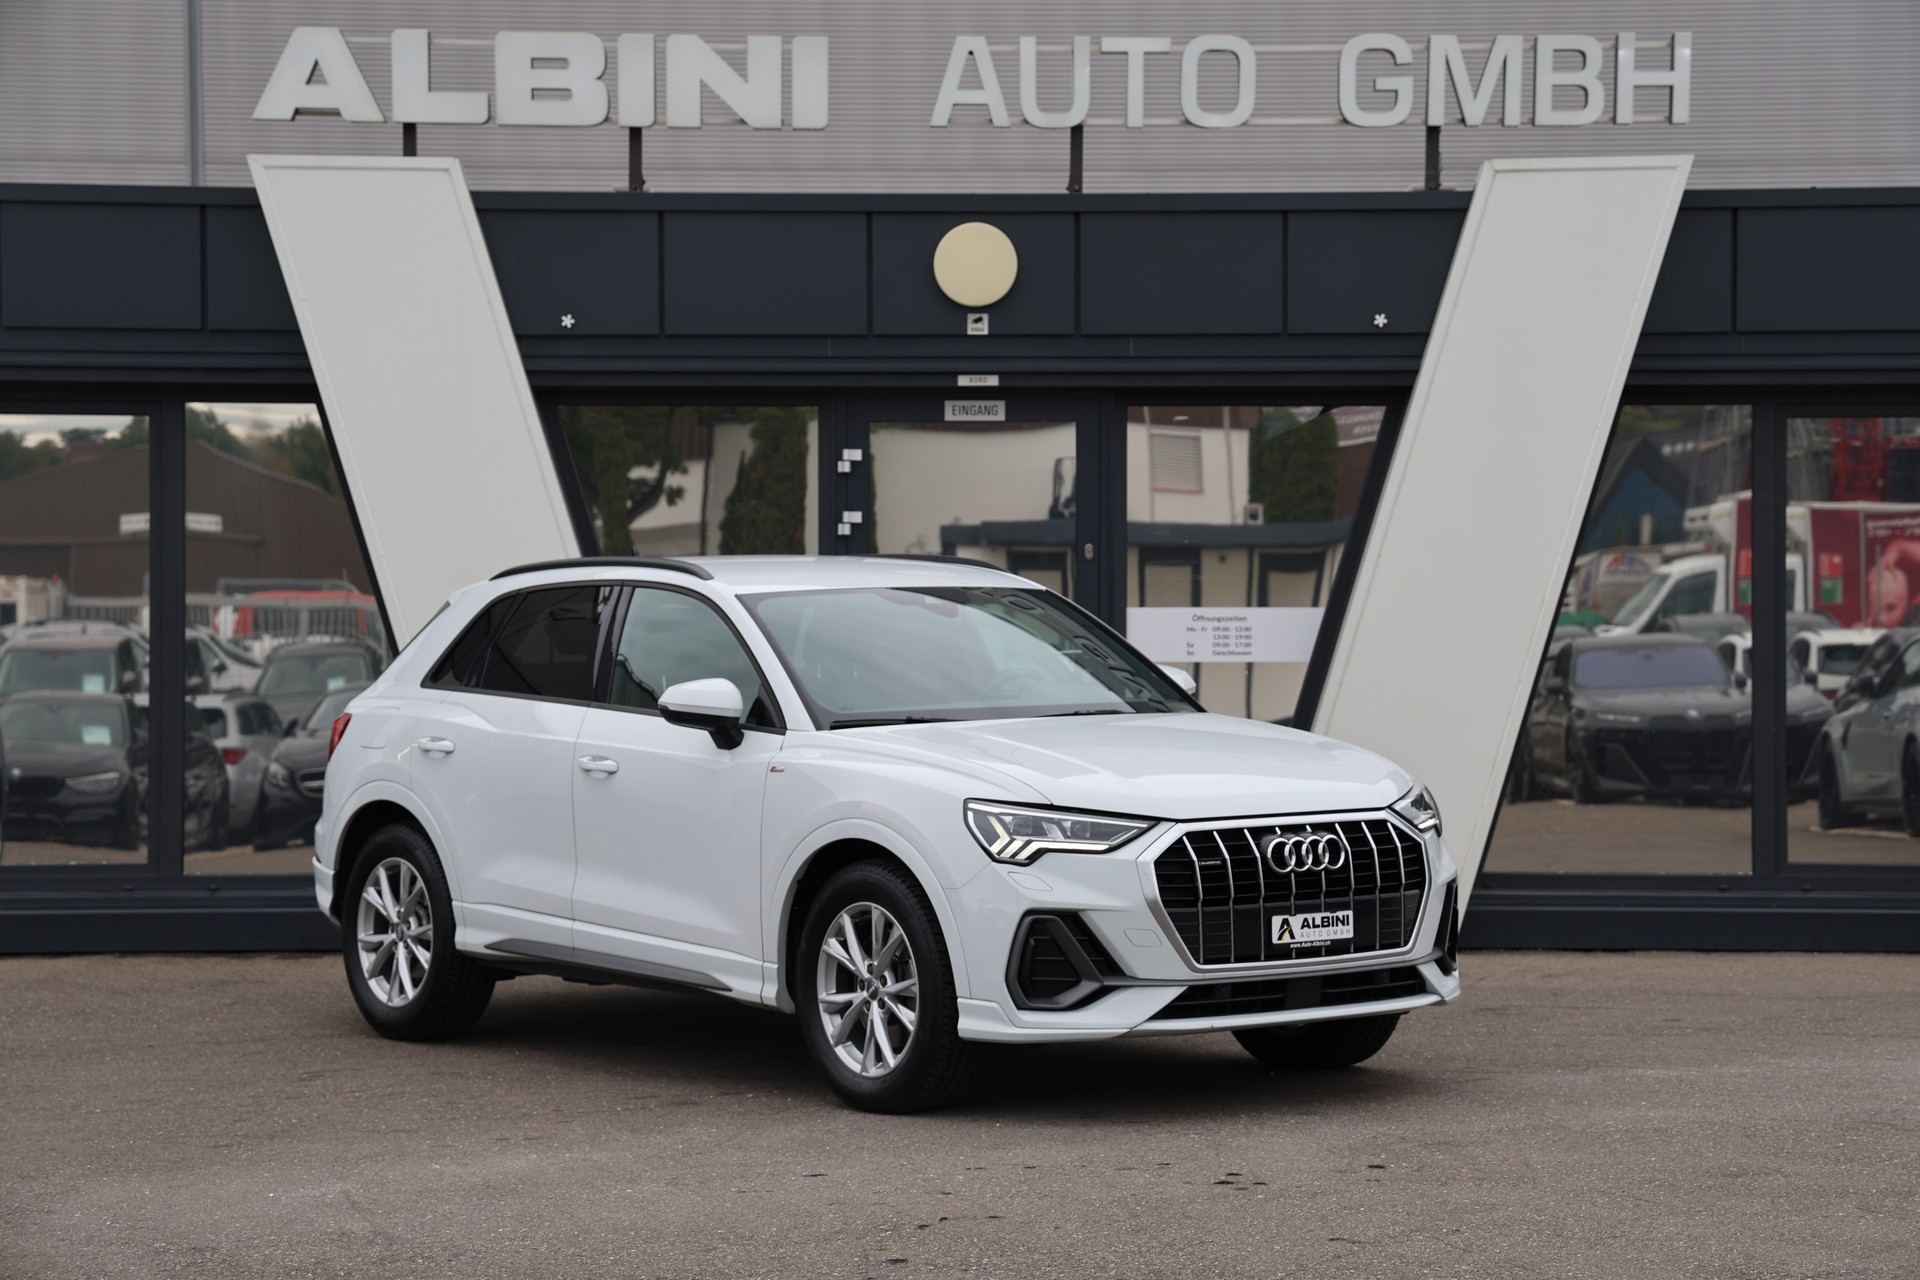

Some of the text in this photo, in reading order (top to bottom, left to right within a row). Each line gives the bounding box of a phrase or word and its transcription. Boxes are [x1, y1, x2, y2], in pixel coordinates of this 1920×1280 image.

[252, 26, 1692, 130] ALBINI AUTO GMBH
[952, 405, 998, 416] EINGANG
[1192, 614, 1247, 623] Öffnungszeiten
[1300, 914, 1350, 929] ALBINI
[1300, 928, 1351, 938] AUTO GMBH
